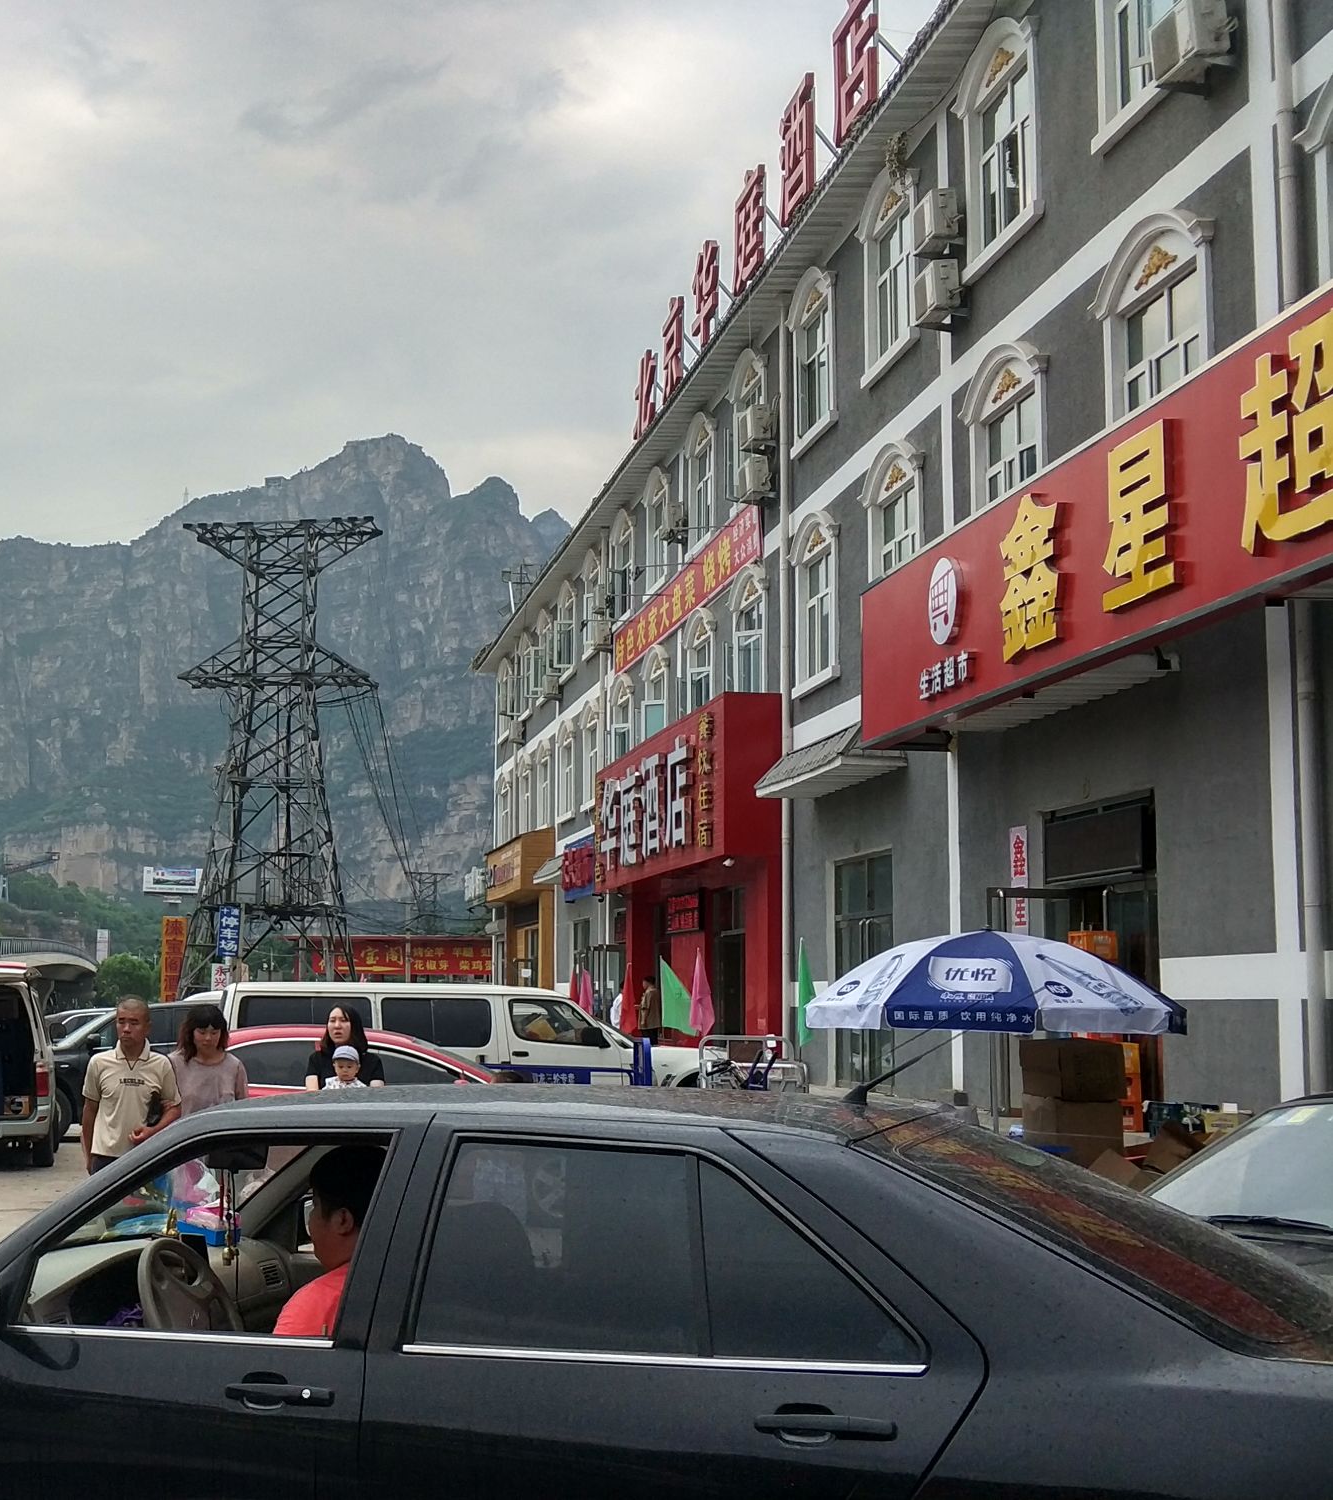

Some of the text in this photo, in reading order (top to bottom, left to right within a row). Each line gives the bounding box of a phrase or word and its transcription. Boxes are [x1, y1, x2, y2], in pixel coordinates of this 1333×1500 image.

[632, 0, 880, 442] 北京华庭酒店
[616, 535, 732, 668] 特色农家大盘菜 烧烤
[918, 650, 970, 701] 生活超市
[600, 735, 695, 872] 华庭酒店
[219, 916, 239, 952] 停车场
[944, 966, 998, 982] 优悦
[894, 1010, 1034, 1024] 国际品质 饮用纯净水
